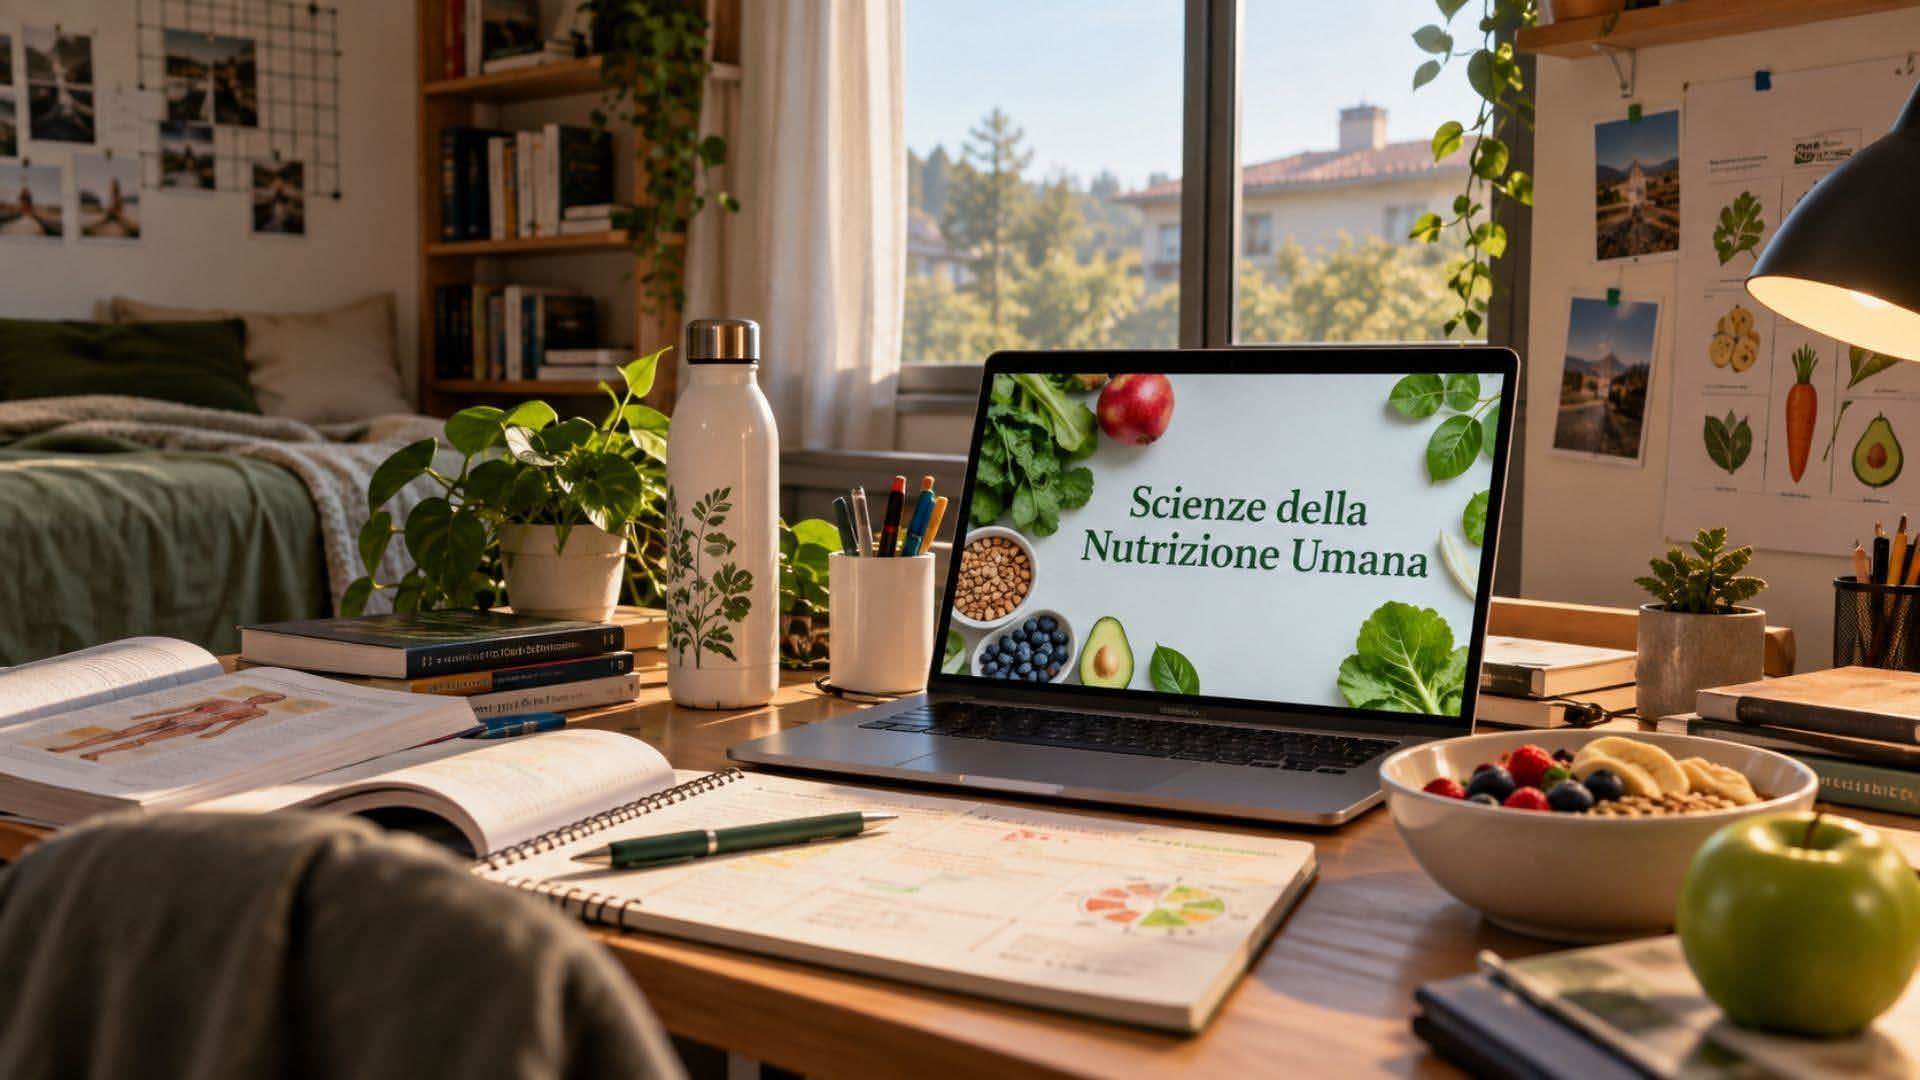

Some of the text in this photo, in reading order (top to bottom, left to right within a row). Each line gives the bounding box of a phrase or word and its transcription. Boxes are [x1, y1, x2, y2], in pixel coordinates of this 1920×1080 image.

[1129, 485, 1368, 527] Scienze della
[1080, 529, 1428, 579] Nutrizione Umana
